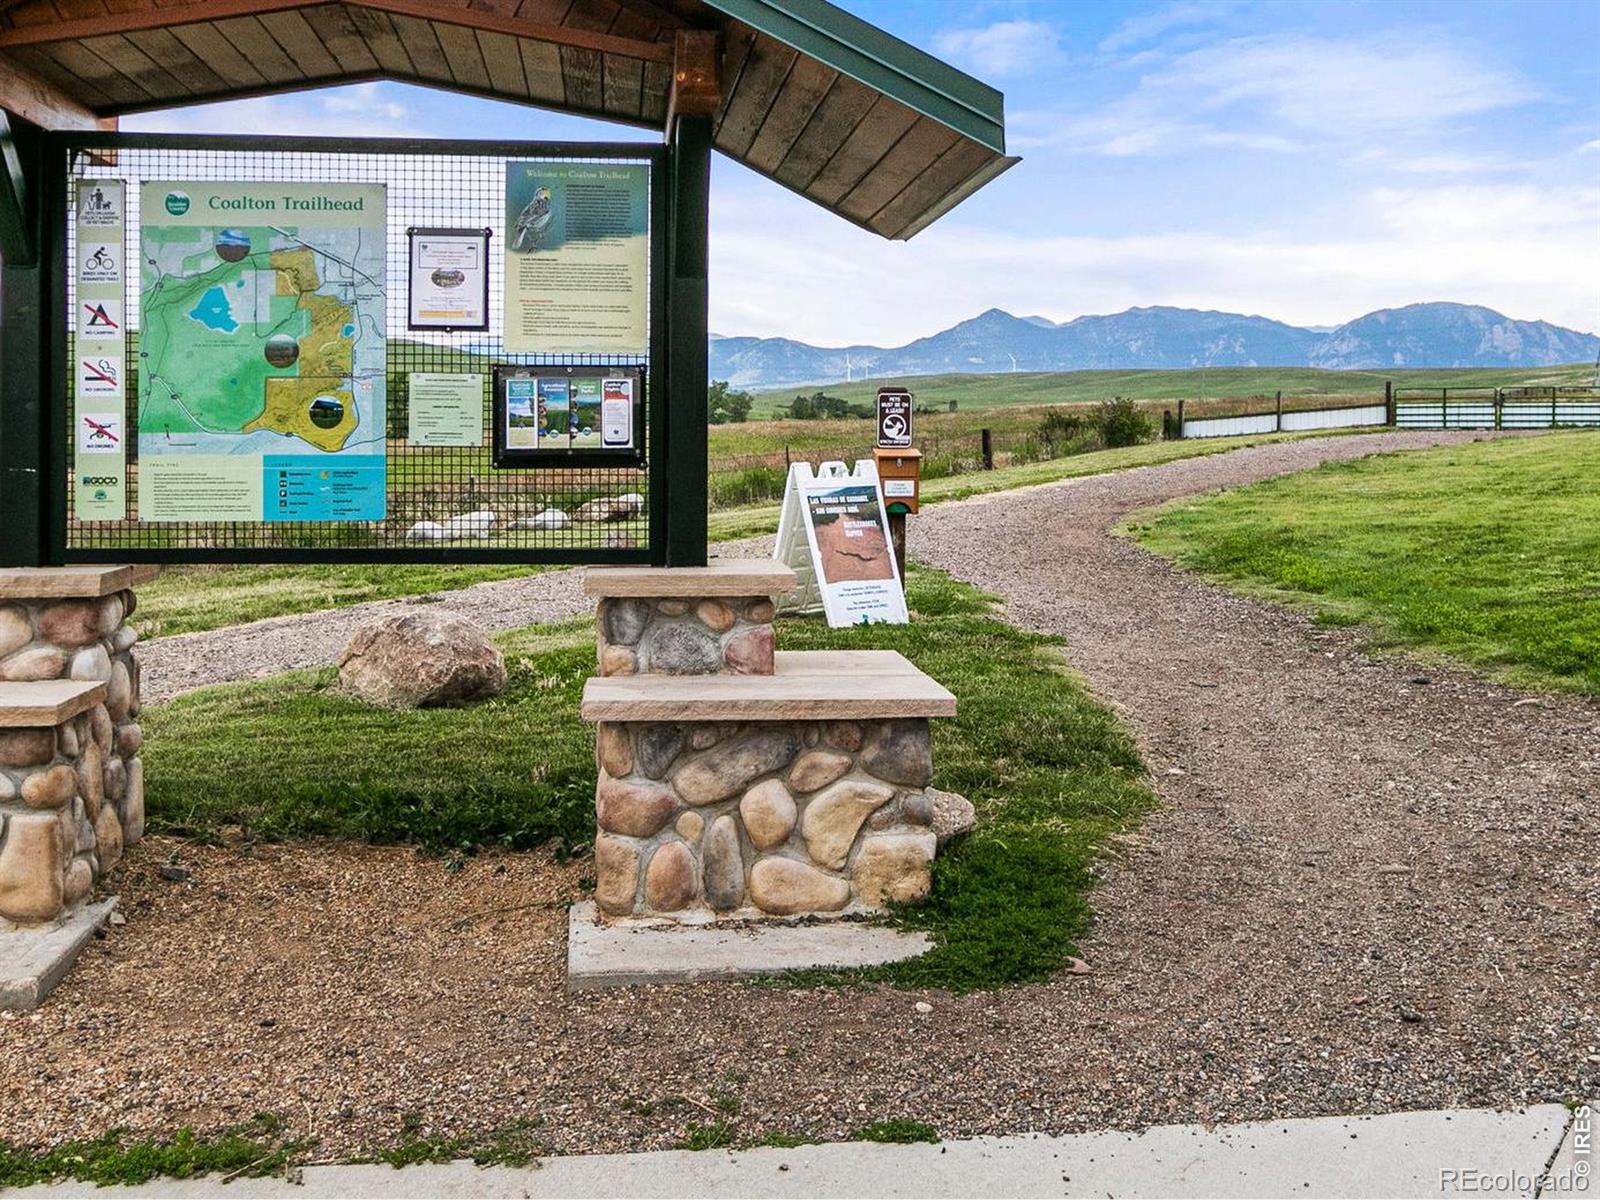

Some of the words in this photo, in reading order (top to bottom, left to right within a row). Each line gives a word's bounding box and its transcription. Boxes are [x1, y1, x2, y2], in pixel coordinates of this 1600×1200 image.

[568, 170, 598, 179] Coalton
[599, 171, 631, 179] Trailhead
[208, 195, 276, 211] Coalton
[282, 196, 364, 211] Trailhead
[91, 476, 118, 485] GOCO
